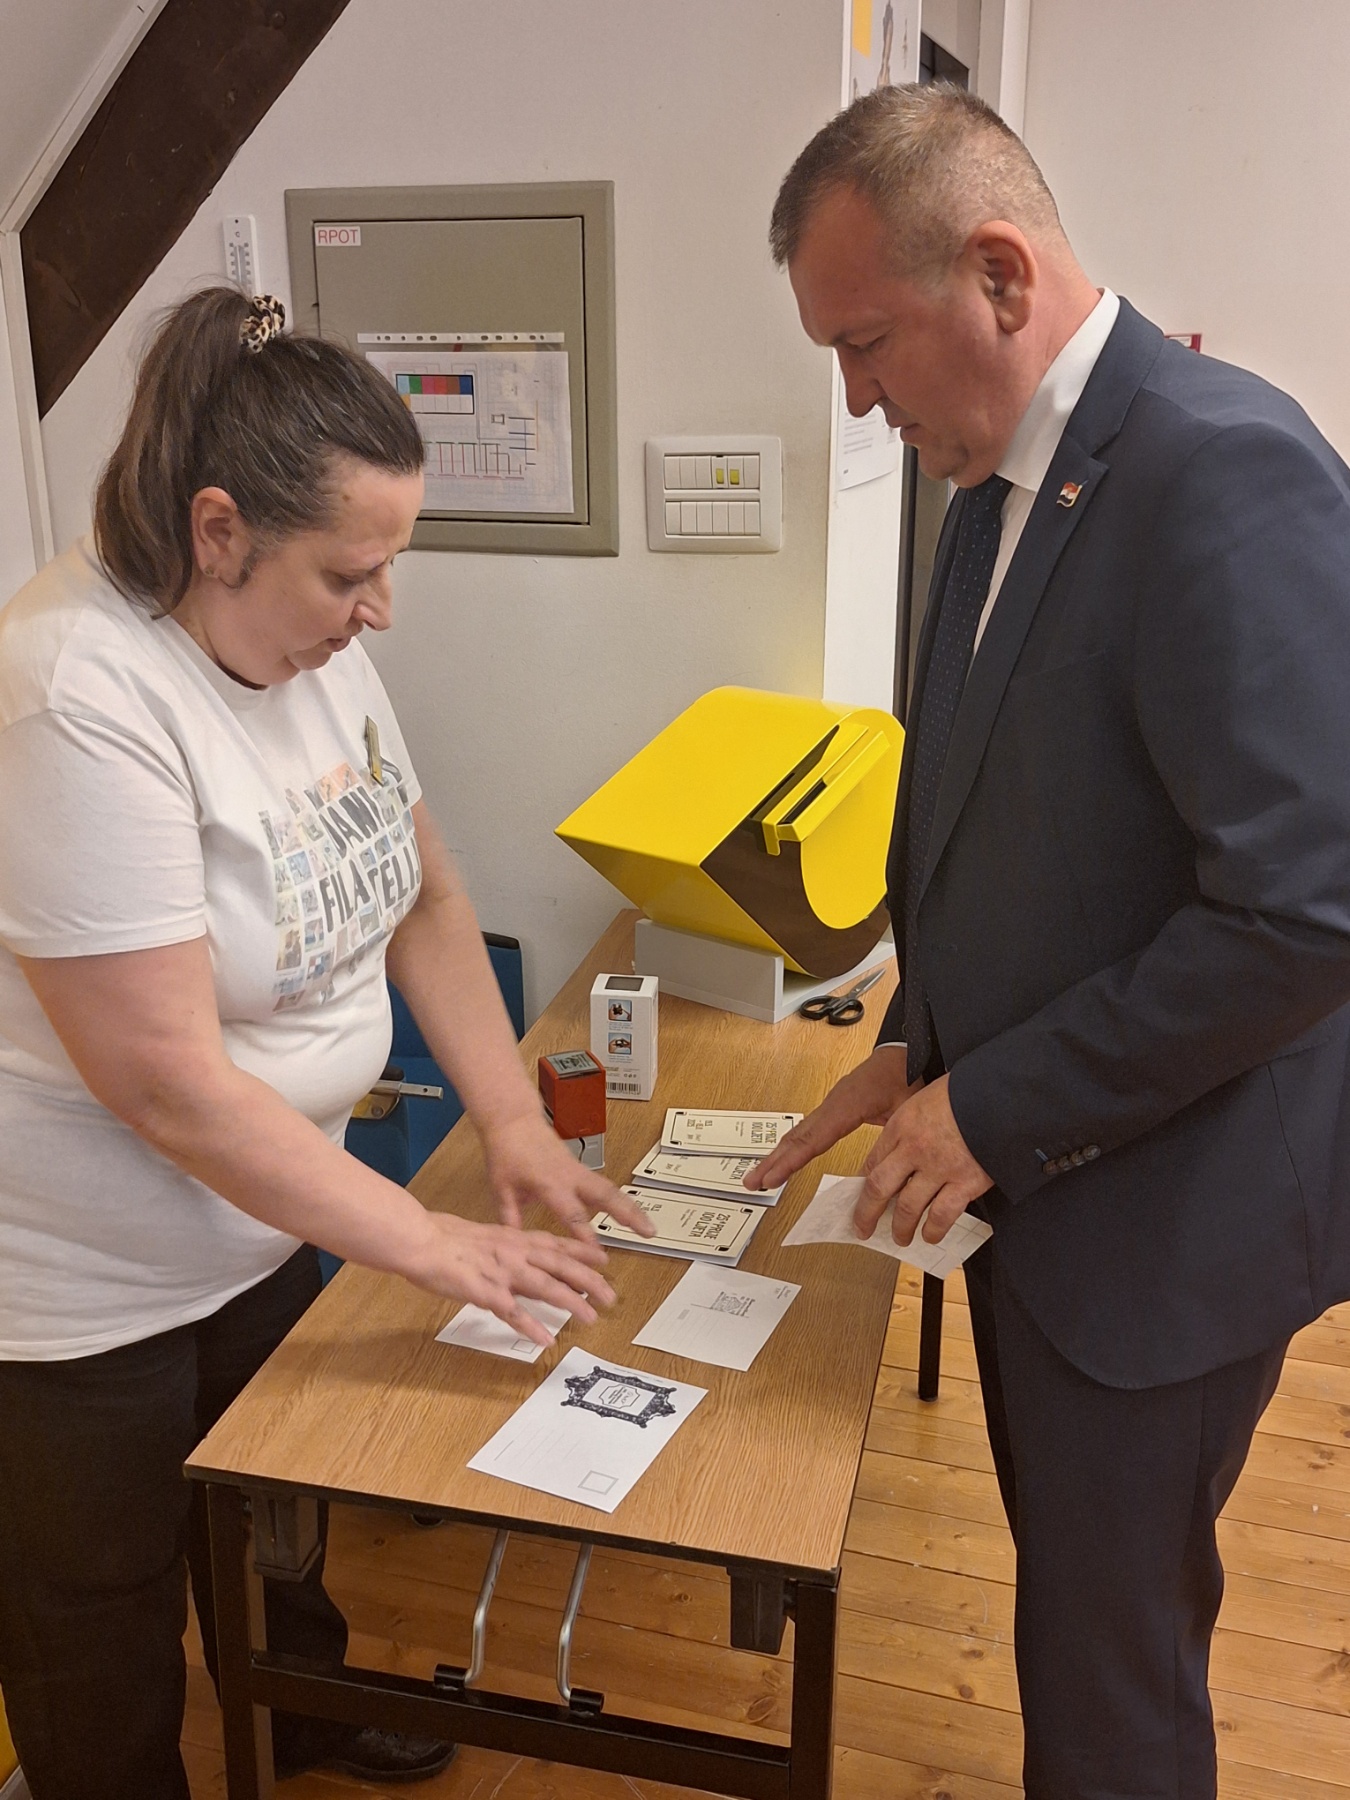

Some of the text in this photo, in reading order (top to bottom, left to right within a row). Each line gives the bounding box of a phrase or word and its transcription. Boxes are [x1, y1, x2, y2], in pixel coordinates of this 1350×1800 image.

[317, 229, 359, 244] RPOT
[699, 1211, 716, 1222] 100
[687, 1220, 708, 1238] LJETA
[703, 1223, 724, 1240] PRIJE
